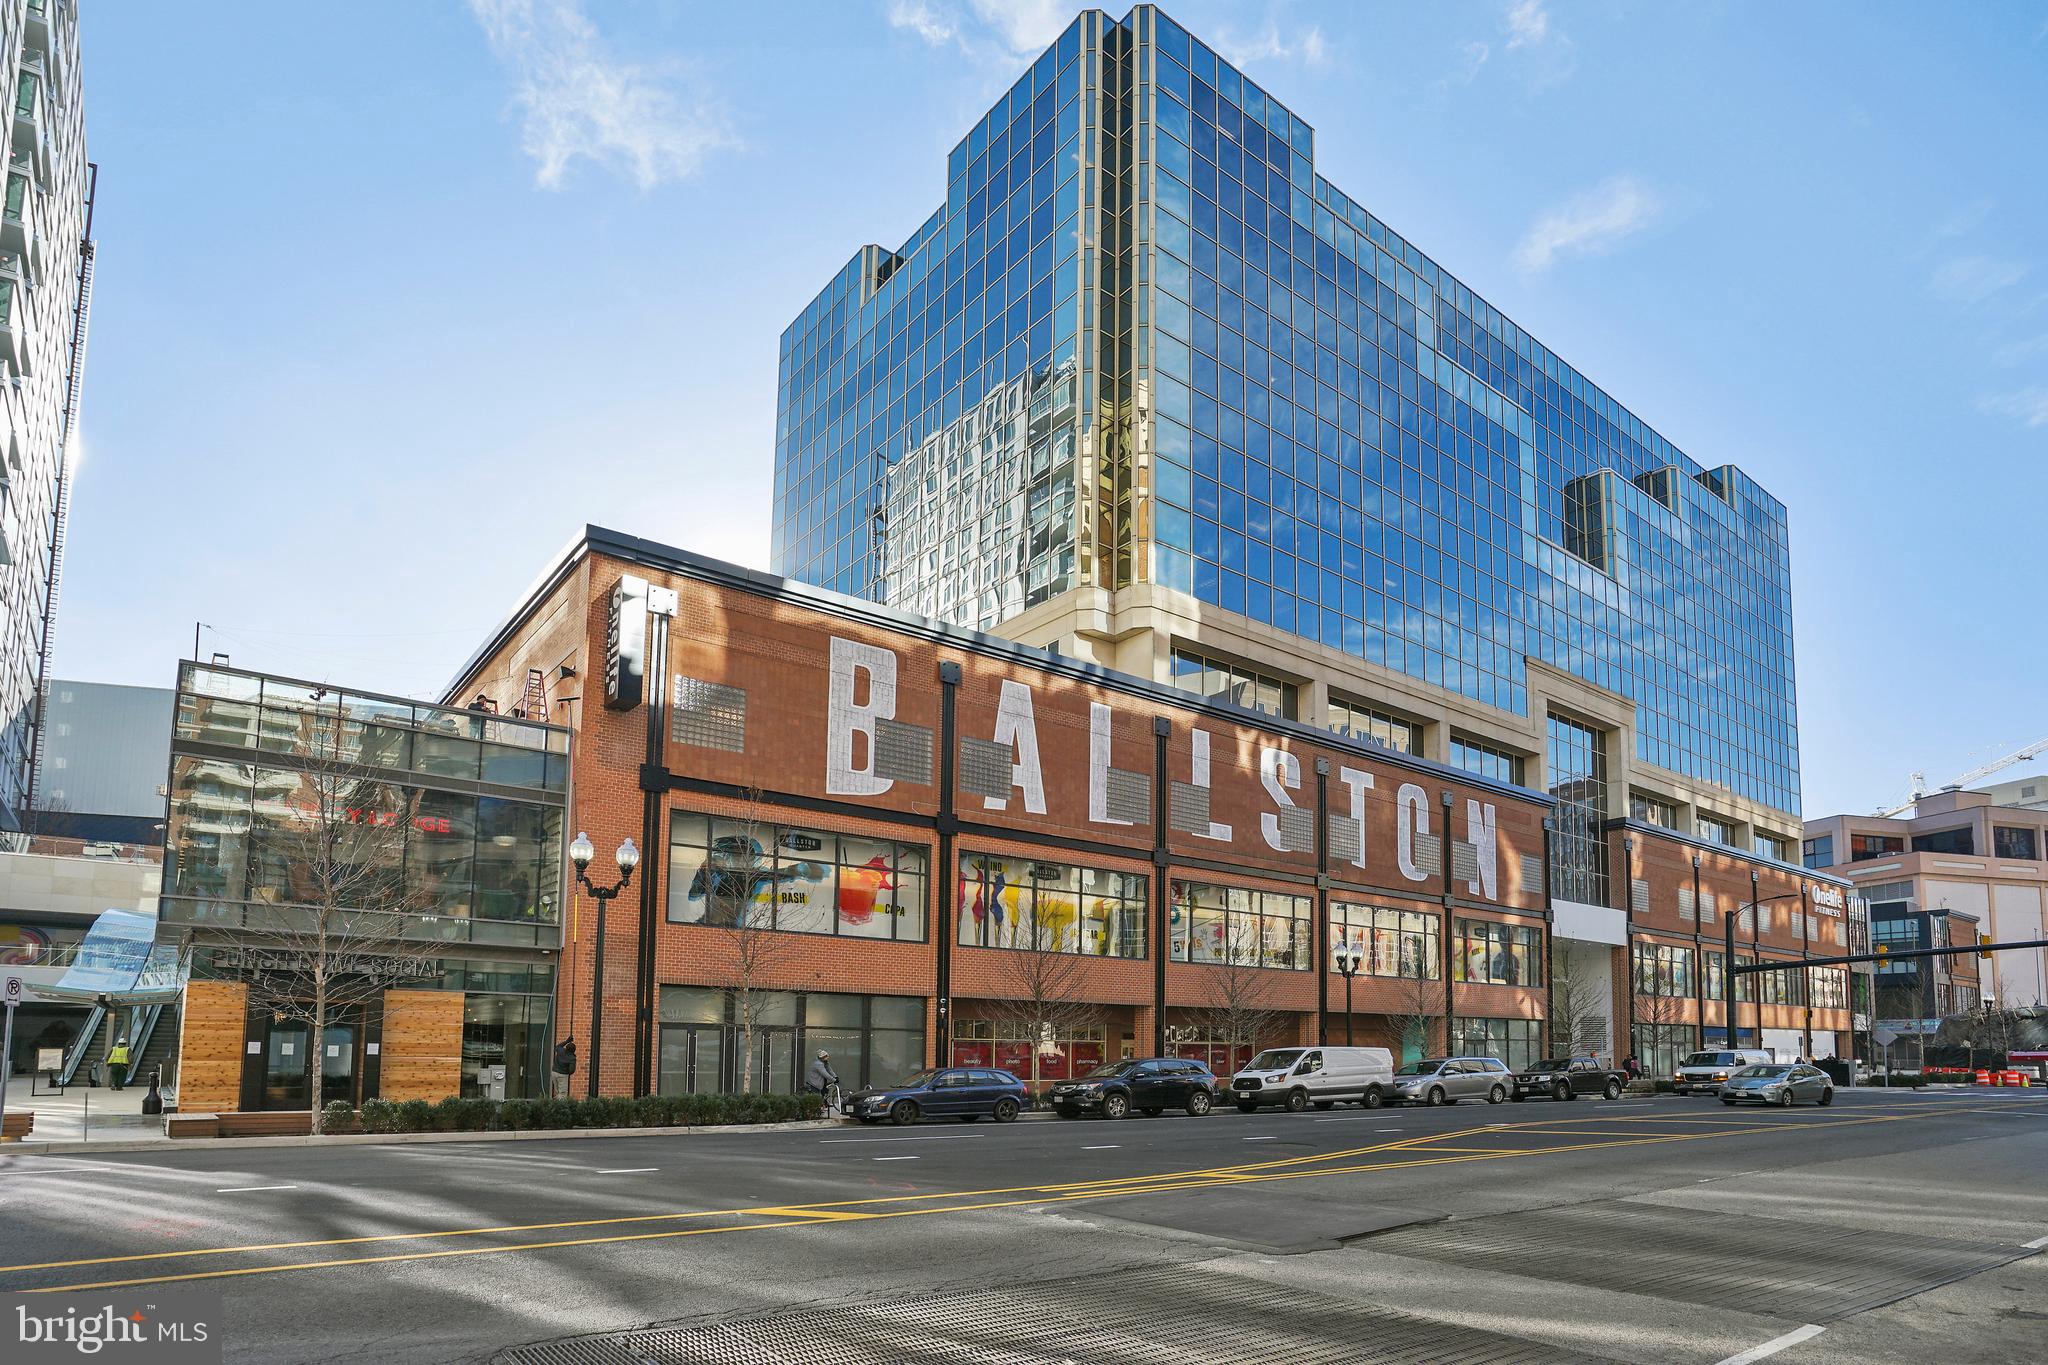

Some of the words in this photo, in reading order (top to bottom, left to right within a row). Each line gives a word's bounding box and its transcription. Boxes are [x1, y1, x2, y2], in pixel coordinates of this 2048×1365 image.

[826, 636, 1497, 901] BALLSTON
[781, 892, 805, 904] BASH
[1812, 885, 1842, 908] Onelife
[1815, 905, 1841, 917] FITNESS
[1076, 1058, 1099, 1066] pharmacy
